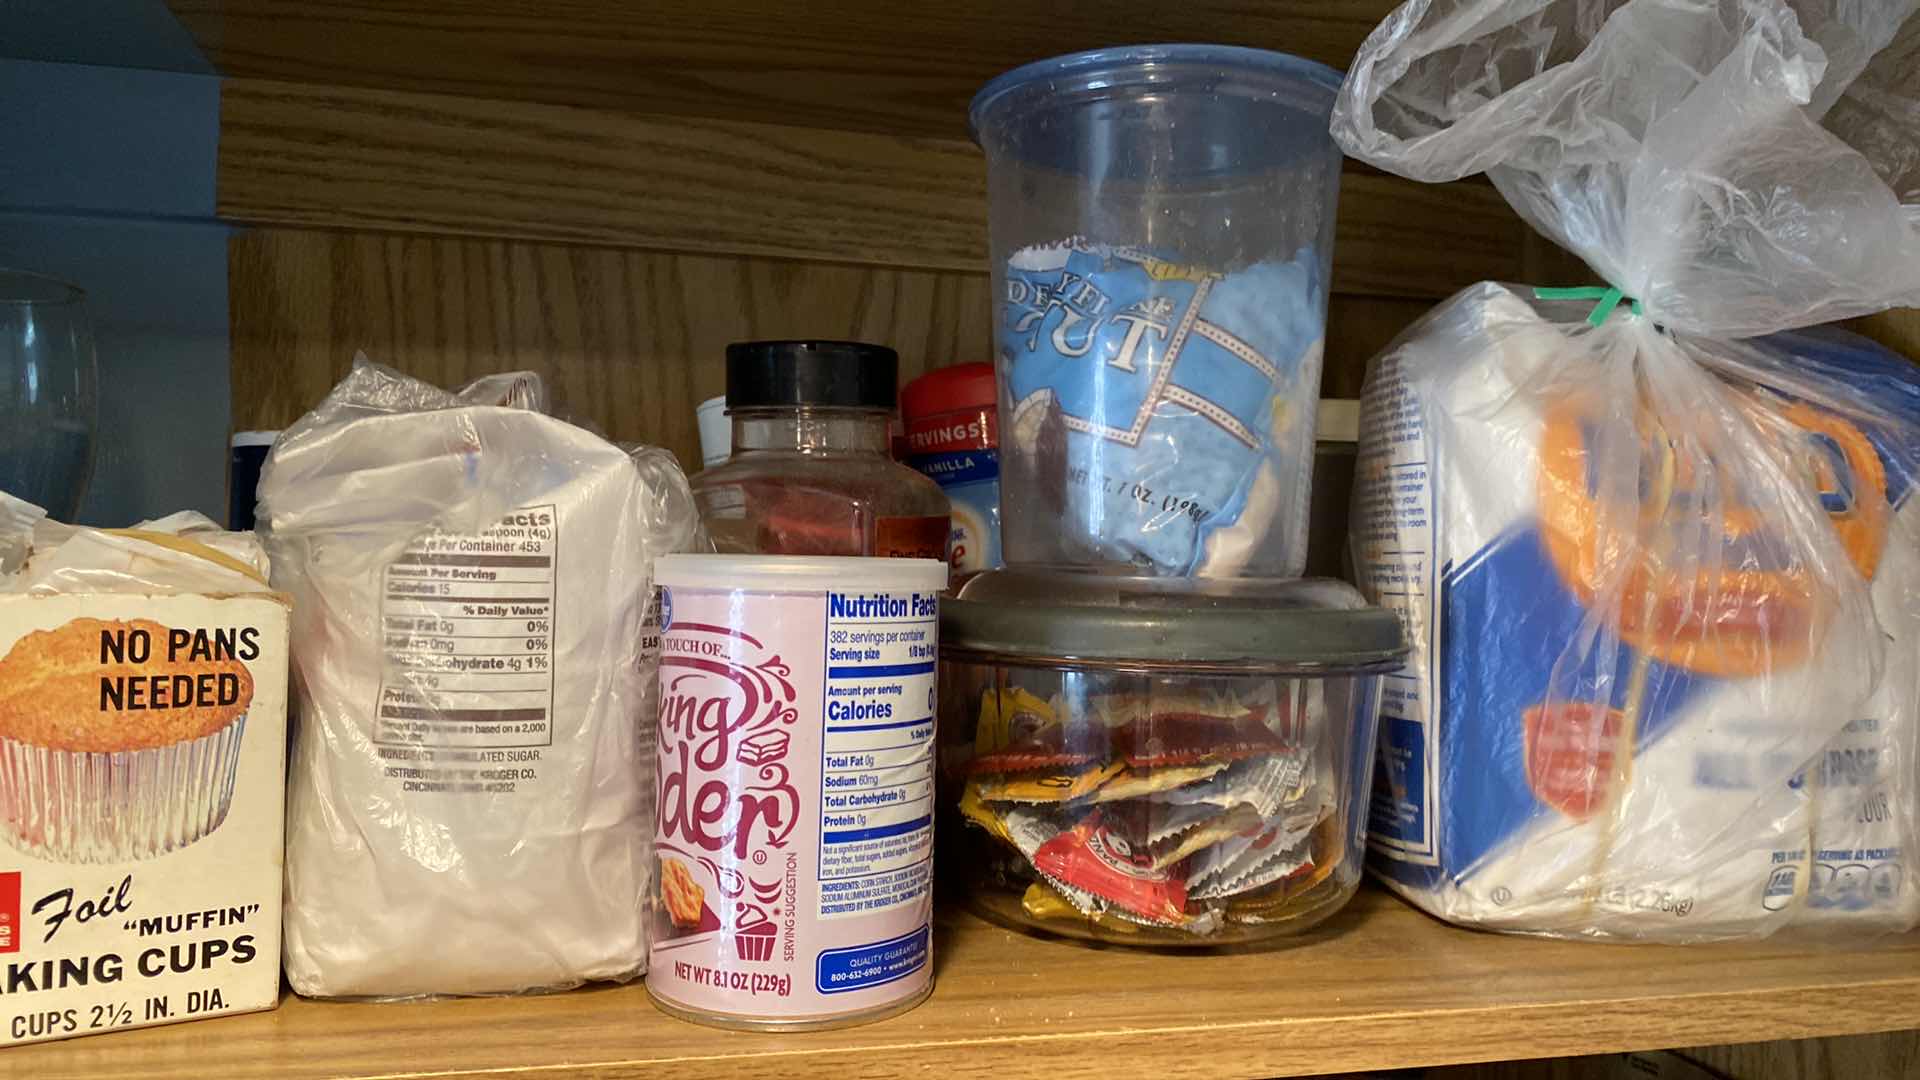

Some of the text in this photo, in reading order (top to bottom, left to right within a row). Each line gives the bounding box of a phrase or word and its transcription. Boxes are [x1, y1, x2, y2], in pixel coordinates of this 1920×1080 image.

[501, 512, 552, 528] acts
[528, 527, 552, 540] (4g)
[459, 539, 515, 553] Container
[519, 541, 542, 553] 453
[430, 567, 450, 578] Per
[451, 568, 497, 581] Serving
[438, 583, 451, 595] 15
[463, 605, 475, 616] %
[477, 605, 508, 618] Daily
[830, 593, 937, 618] Nutrition Facts
[417, 618, 437, 631] Fat
[440, 619, 455, 634] 0g
[526, 620, 550, 633] 0%
[100, 626, 261, 665] NO PANS
[525, 637, 549, 650] 0%
[642, 635, 661, 649] EAS
[666, 637, 700, 654] TOUCH
[830, 630, 848, 643] 382
[850, 631, 885, 646] servings
[886, 632, 899, 644] per
[829, 647, 863, 662] Serving
[864, 647, 881, 660] size
[506, 657, 523, 672] 4g
[526, 657, 549, 670] 1%
[100, 672, 240, 712] NEEDED
[828, 683, 902, 698] Amount per serving
[828, 699, 893, 721] Calories
[475, 723, 501, 735] based
[502, 724, 514, 734] on
[522, 722, 547, 735] 2,000
[825, 756, 849, 768] Total
[850, 755, 864, 767] Fat
[521, 768, 537, 780] CO.
[825, 774, 879, 788] Sodium 60mg
[825, 796, 847, 807] Total
[849, 791, 898, 806] Carbohydrate
[824, 816, 855, 827] Protein
[785, 852, 798, 919] SUGGESTION
[31, 873, 134, 944] Foil
[783, 919, 796, 962] SERVING
[0, 934, 258, 996] KING CUPS
[849, 952, 884, 968] QUALITY
[674, 960, 792, 997] NET WT 8.1 OZ (229g)
[11, 1008, 78, 1040] CUPS
[145, 994, 176, 1021] IN.
[186, 987, 230, 1014] DIA.
